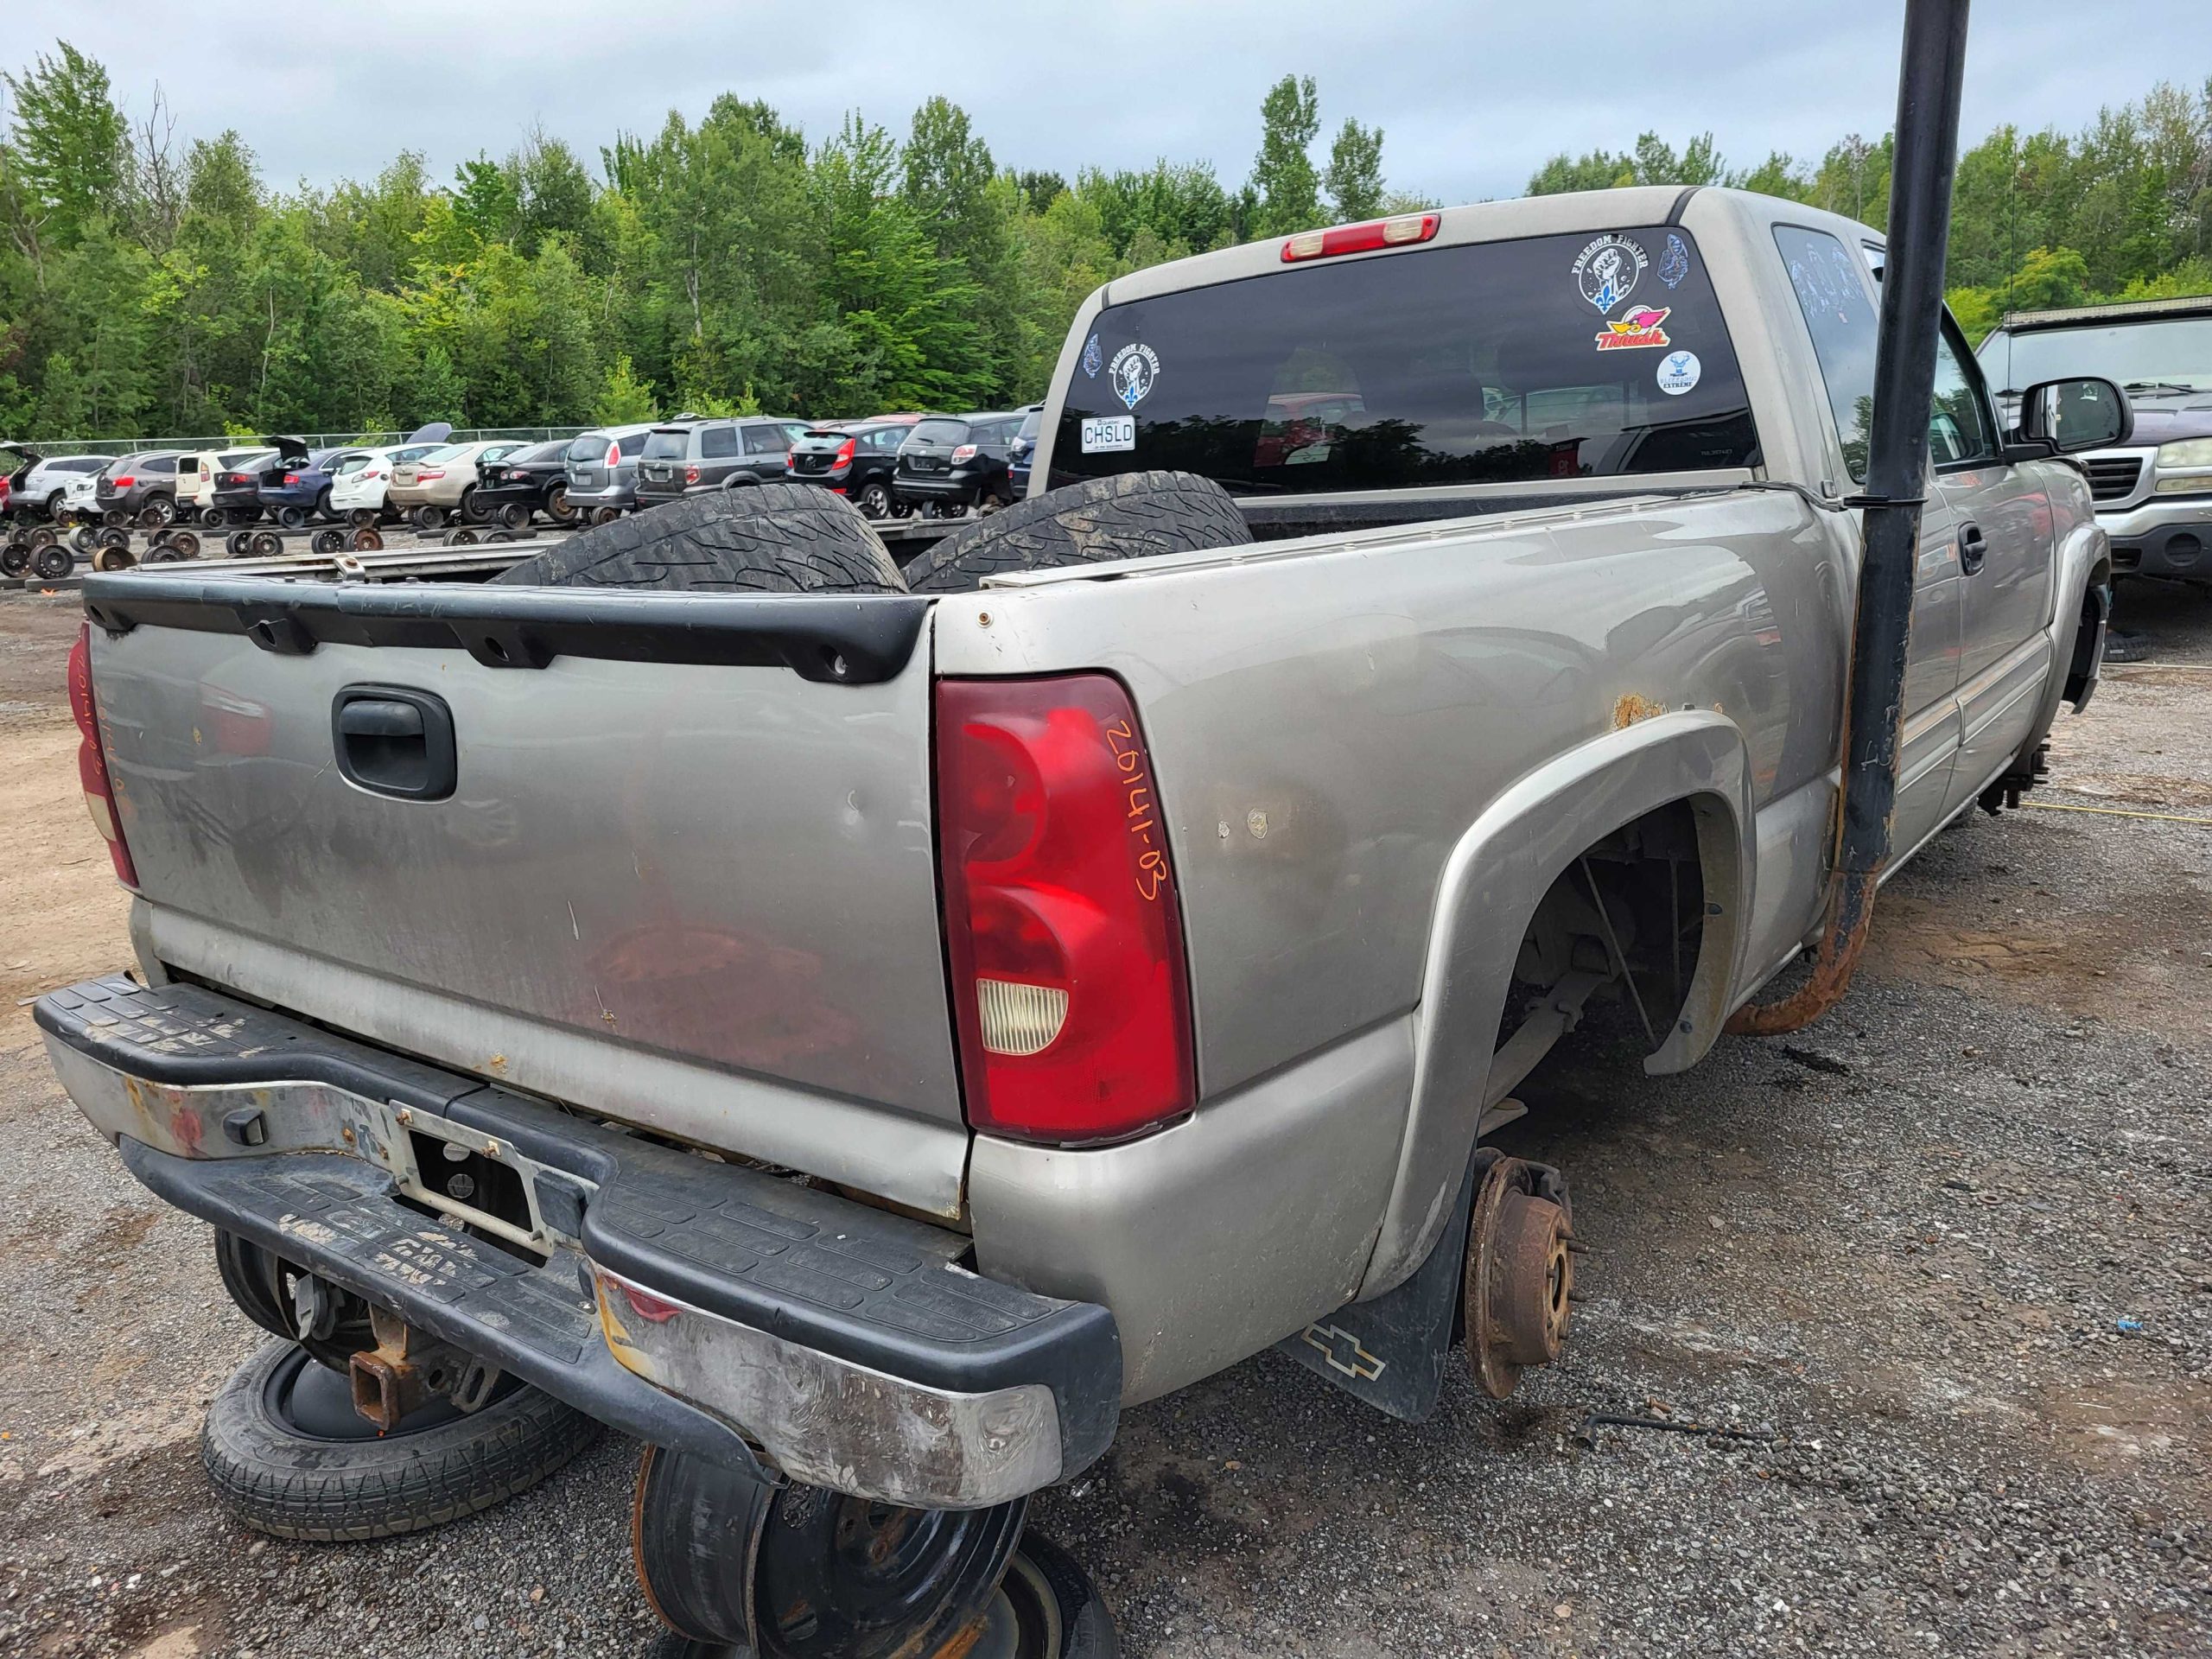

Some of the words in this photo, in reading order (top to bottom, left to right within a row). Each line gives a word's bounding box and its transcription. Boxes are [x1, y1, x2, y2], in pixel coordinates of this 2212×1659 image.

[1571, 234, 1612, 275] FREEDOM
[1616, 234, 1649, 270] FIGHTER
[1109, 343, 1137, 374] FREEDOM
[1140, 343, 1160, 374] FIGHTER
[1084, 424, 1133, 444] CHSLD
[1106, 720, 1167, 900] 20141-03
